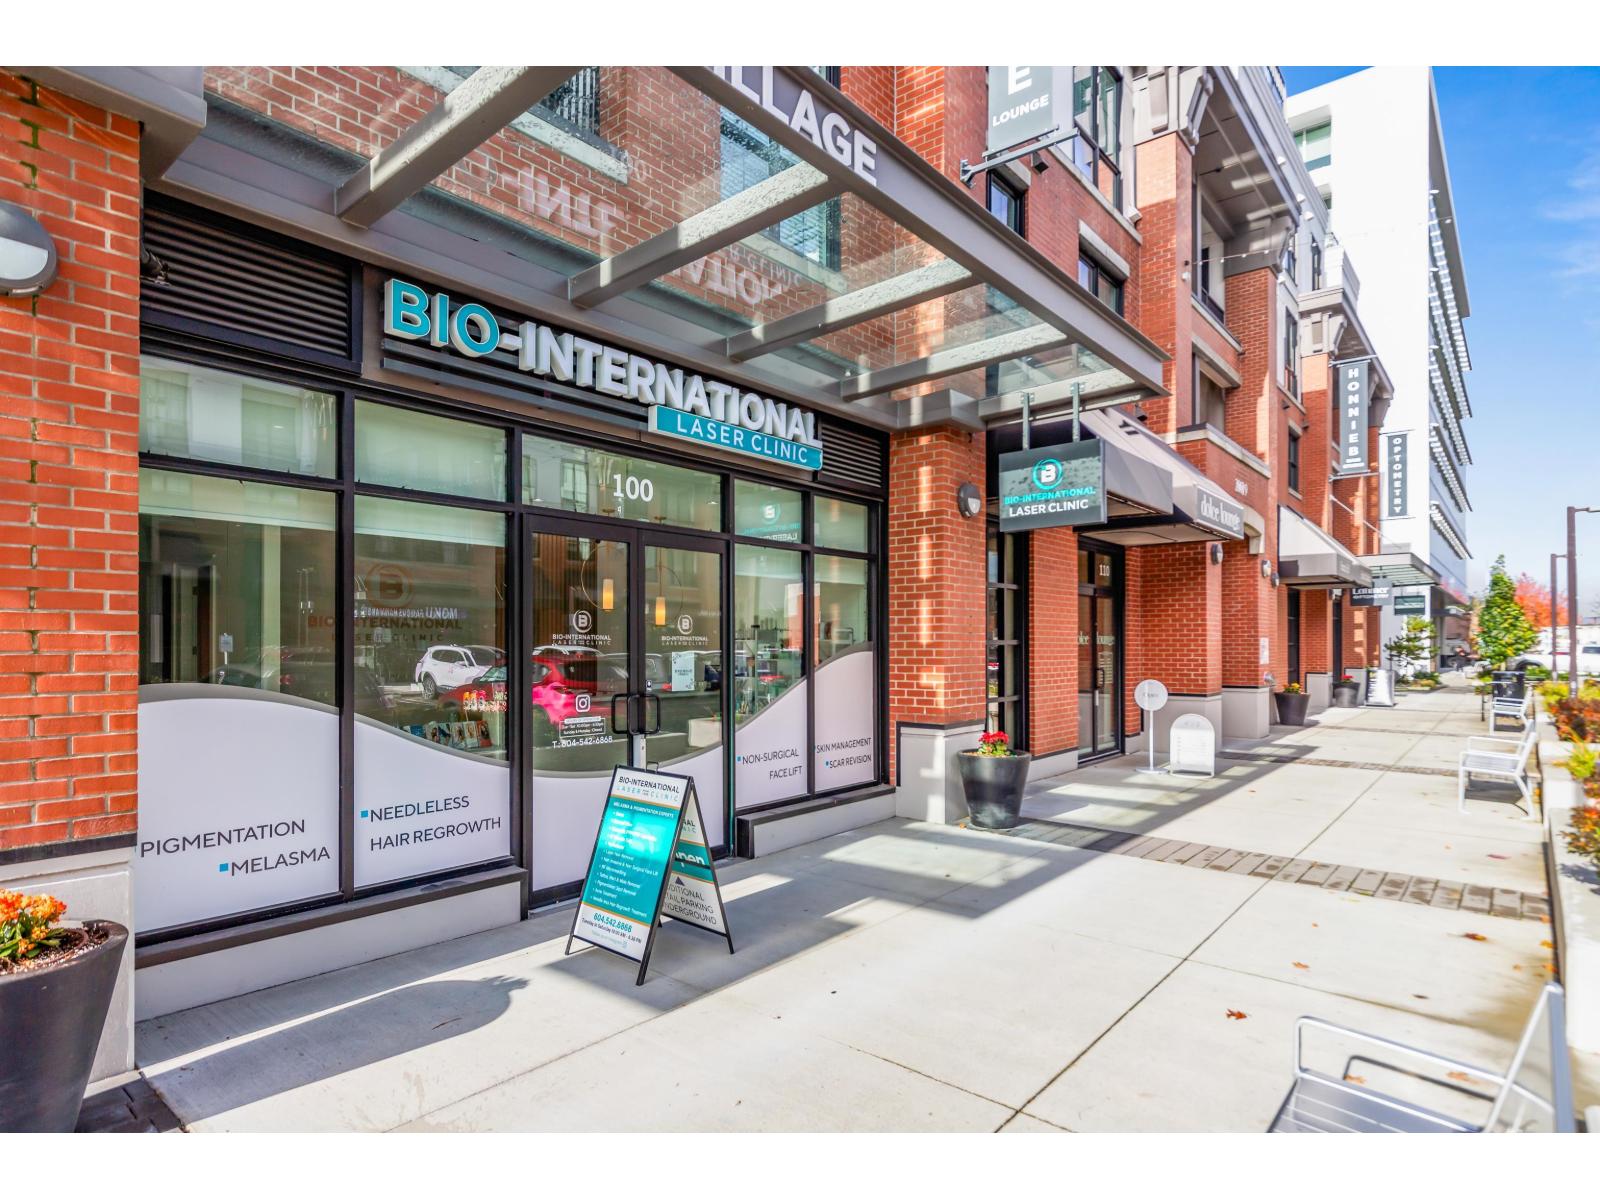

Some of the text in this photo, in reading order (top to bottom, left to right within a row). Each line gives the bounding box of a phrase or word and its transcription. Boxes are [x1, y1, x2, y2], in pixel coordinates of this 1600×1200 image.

[992, 94, 1049, 127] LOUNGE
[384, 278, 823, 450] BIO-INTERNATIONAL
[676, 414, 808, 464] LASER CLINIC
[613, 473, 654, 502] 100
[1004, 486, 1097, 505] BIO-INTERNATIONAL
[1009, 499, 1089, 517] LASER CLINIC
[1099, 564, 1110, 577] 110
[661, 635, 708, 643] BIO-INTERNATIONAL
[816, 737, 872, 754] SKIN MANAGEMENT
[742, 748, 800, 765] NON-SURGICAL
[829, 754, 872, 769] SCAR REVISION
[769, 765, 803, 780] FACE LIFT
[618, 776, 680, 794] BIO-INTERNATIONAL
[370, 795, 470, 823] NEEDLELESS
[140, 819, 305, 858] PIGMENTATION
[370, 816, 501, 851] HAIR REGROWTH
[231, 846, 331, 877] MELASMA
